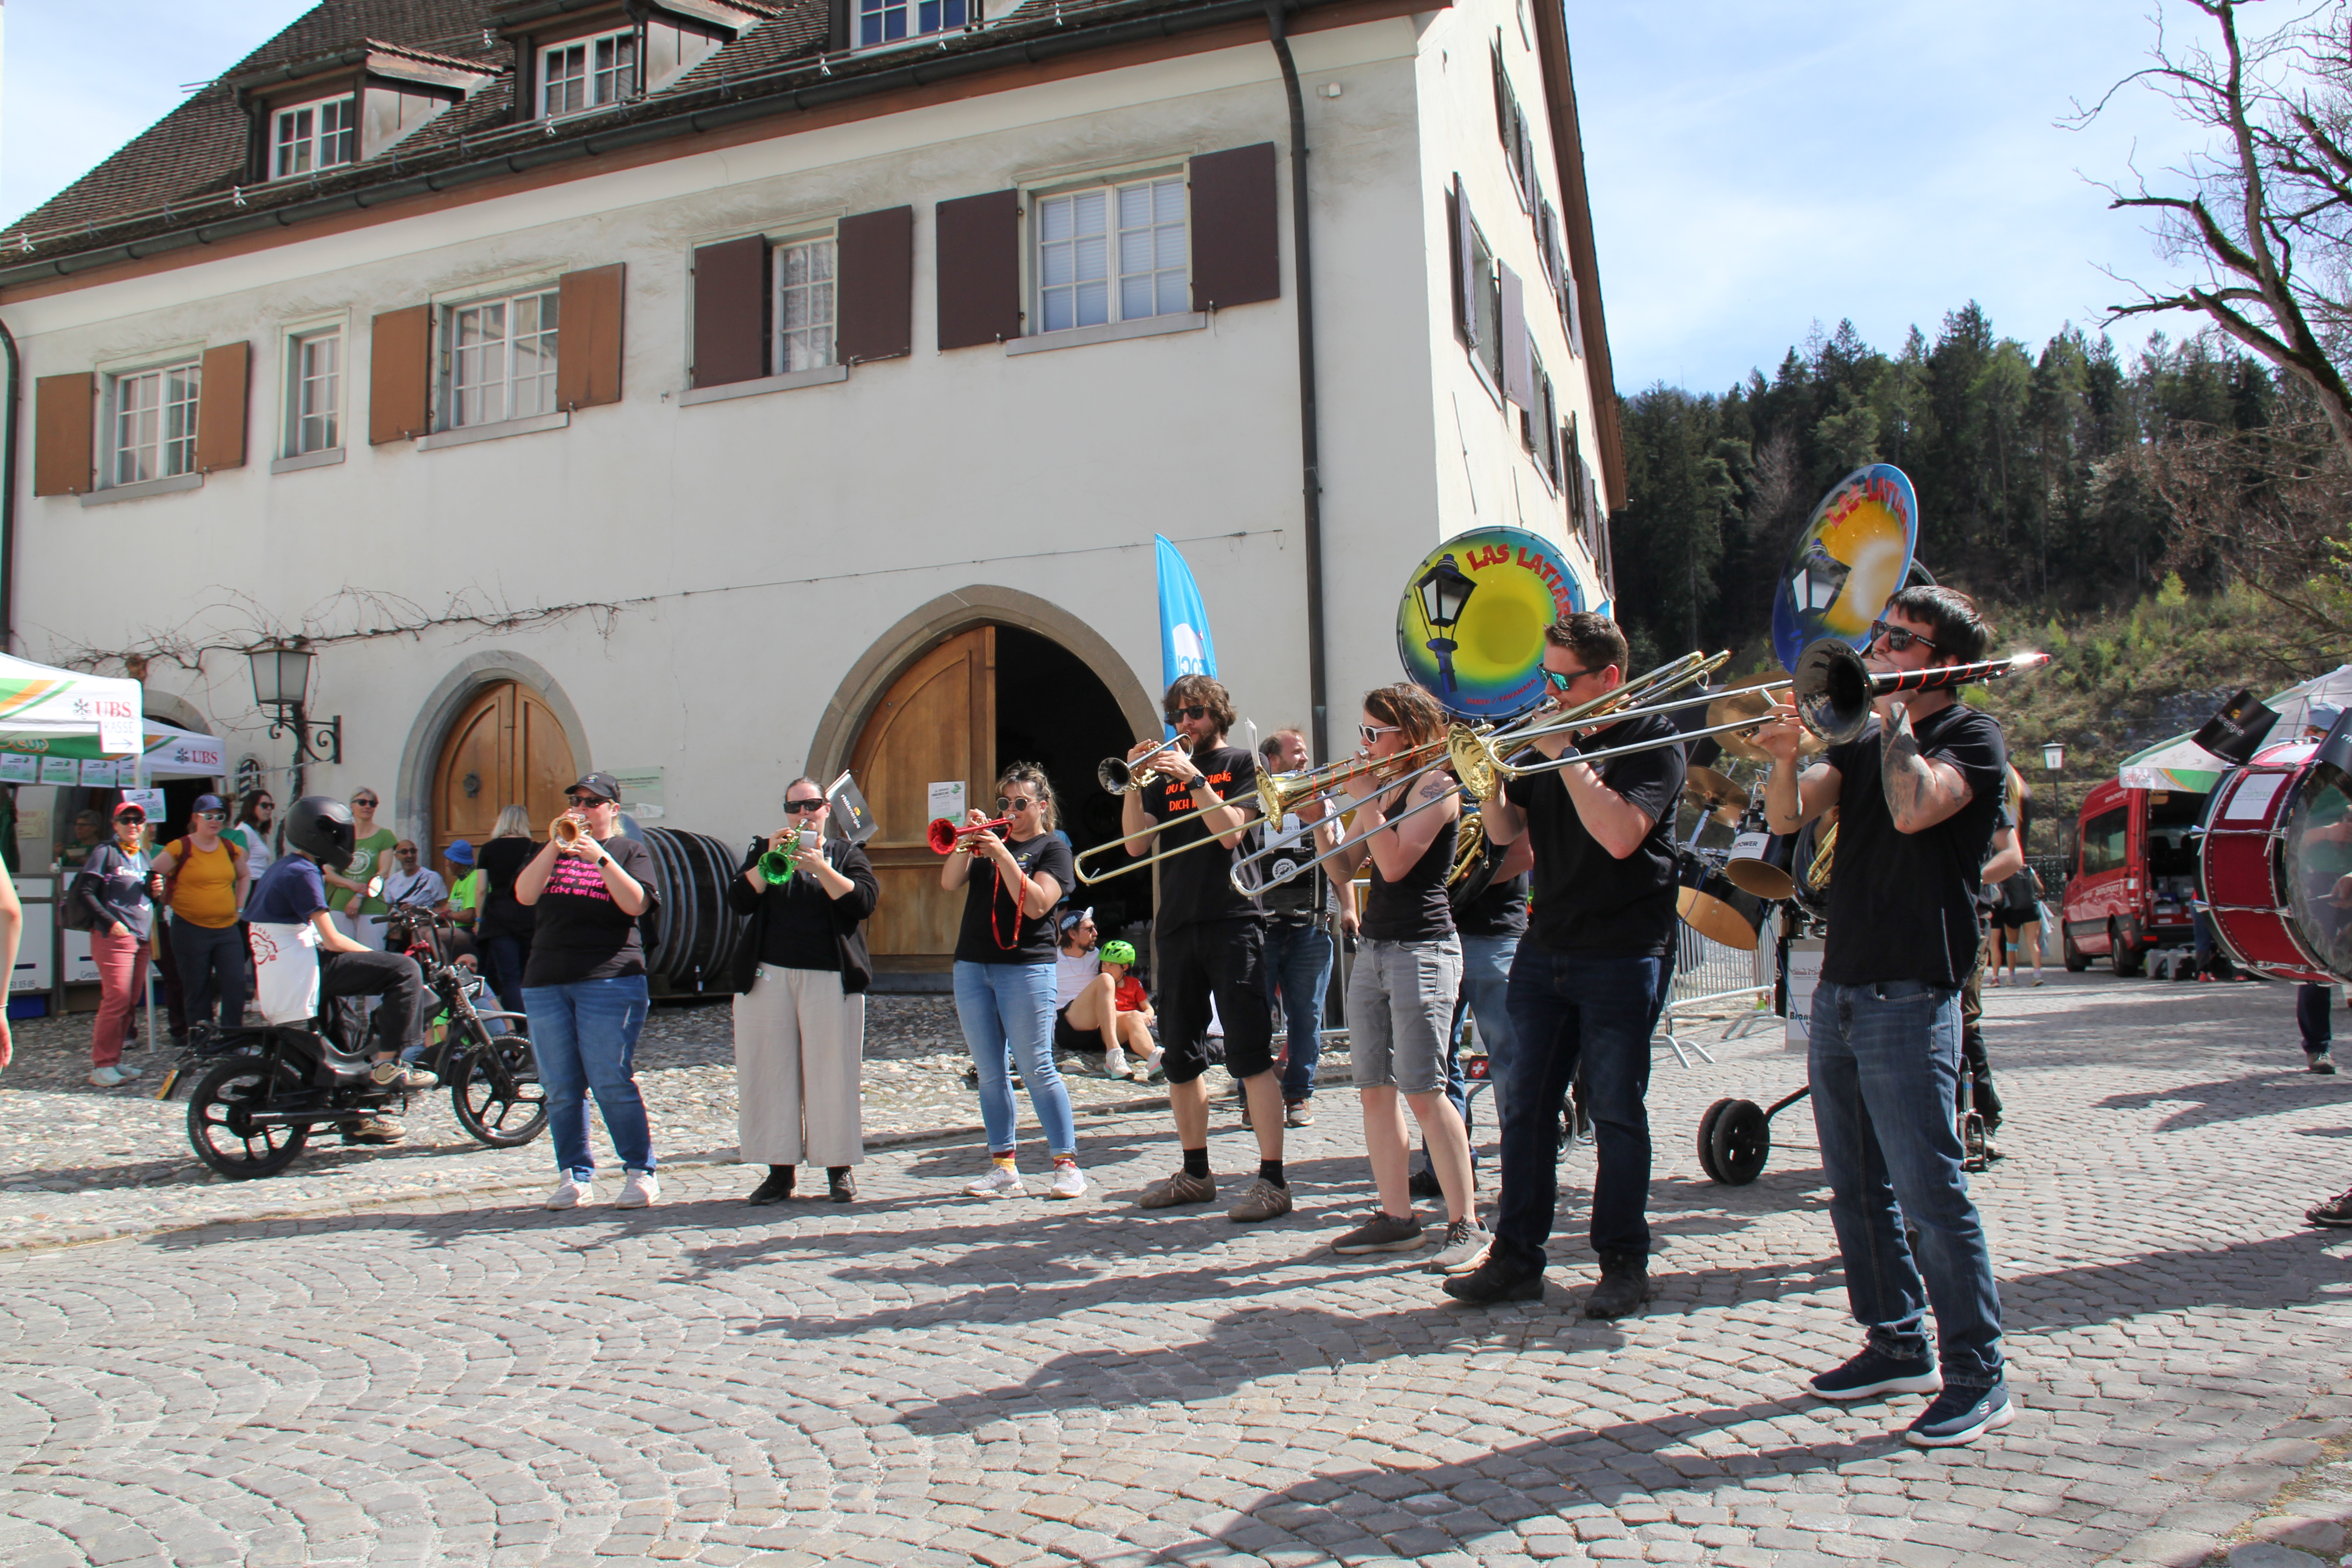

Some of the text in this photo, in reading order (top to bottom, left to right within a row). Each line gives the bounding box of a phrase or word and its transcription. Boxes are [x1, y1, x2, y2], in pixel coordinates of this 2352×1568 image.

[1826, 484, 1861, 530] LAS
[1466, 543, 1572, 620] LAS LATIAR
[1499, 678, 1537, 702] TAVANASA
[95, 701, 132, 718] UBS
[103, 721, 135, 733] KASSE
[192, 750, 218, 764] UBS
[1166, 784, 1178, 795] DU
[1169, 799, 1190, 812] DICH
[550, 885, 571, 894] Ecke
[572, 887, 589, 896] und
